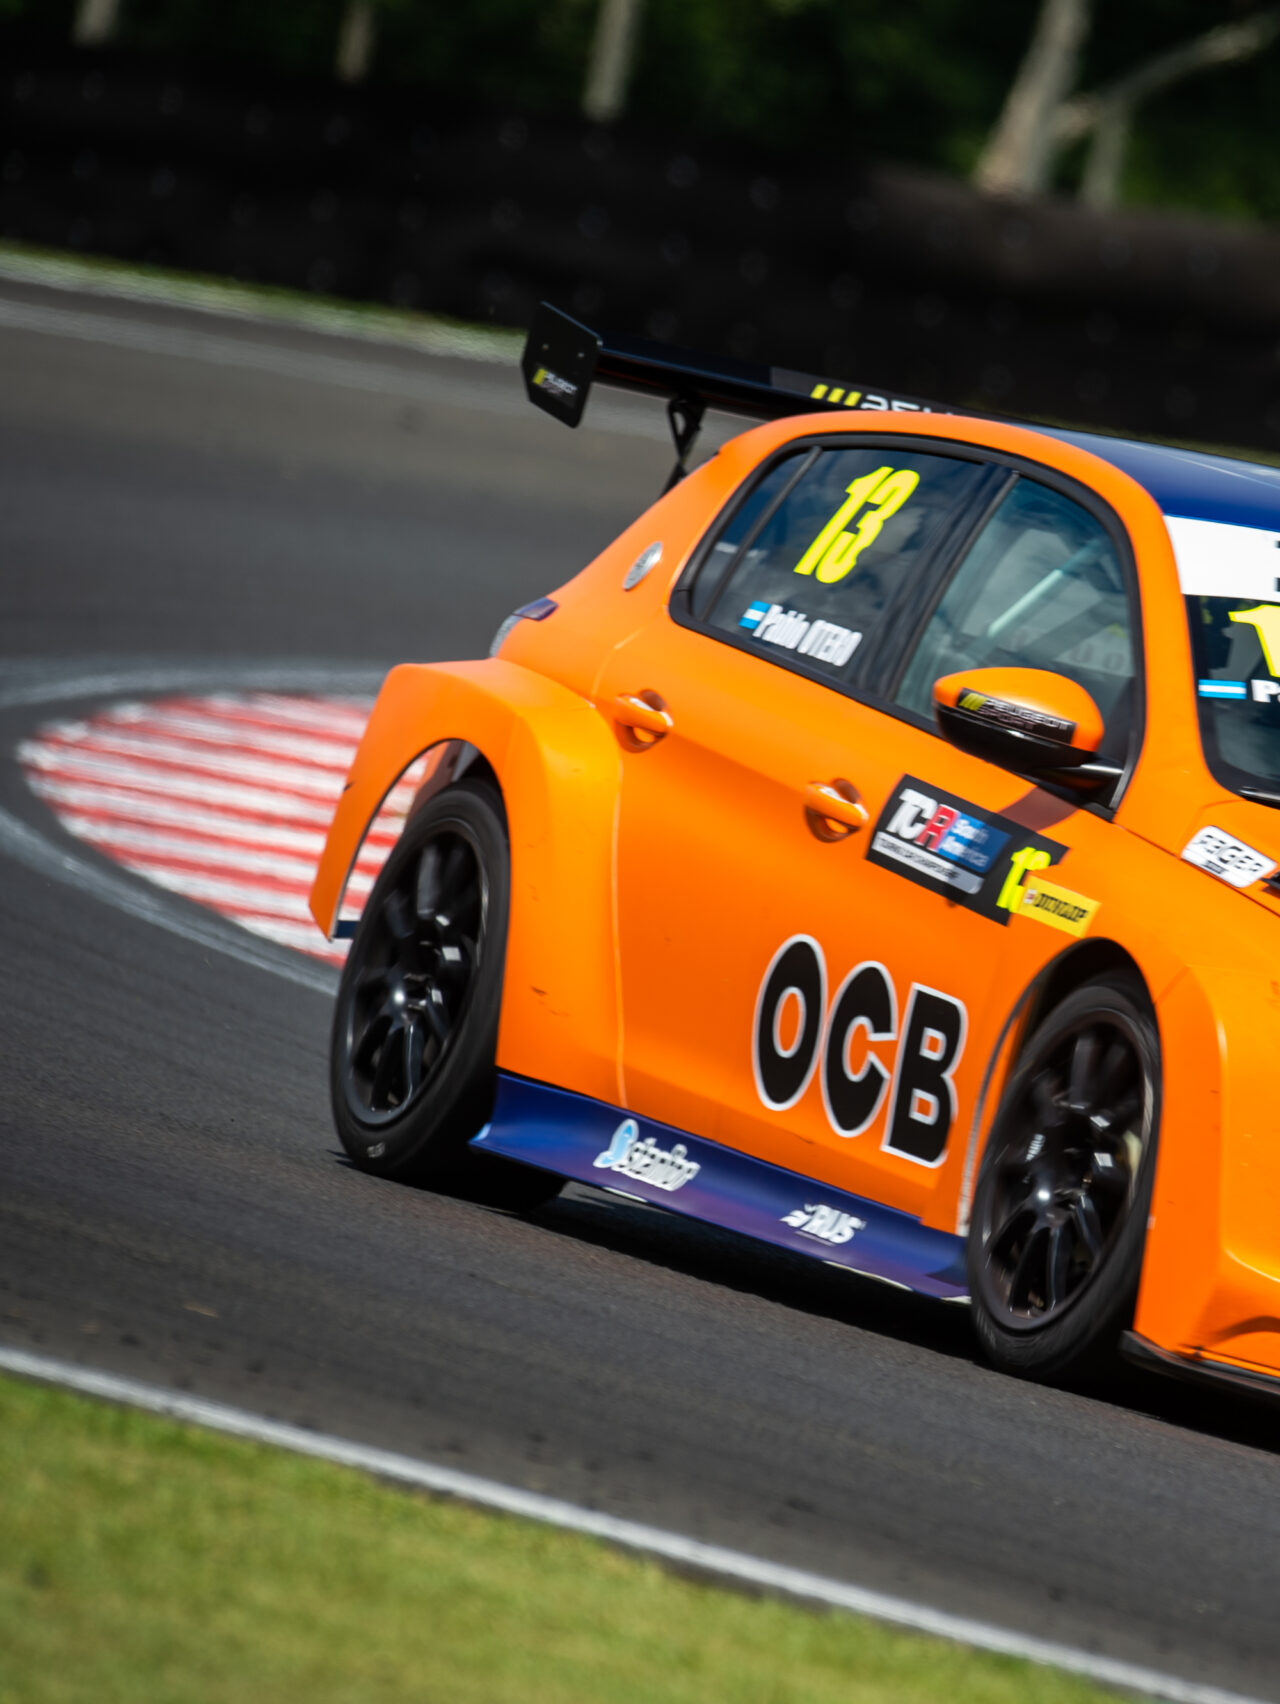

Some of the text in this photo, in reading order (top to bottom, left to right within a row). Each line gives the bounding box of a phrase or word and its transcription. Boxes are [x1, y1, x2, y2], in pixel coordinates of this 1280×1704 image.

[793, 467, 921, 584] 13
[885, 788, 958, 853] TCR
[752, 933, 969, 1169] OCB
